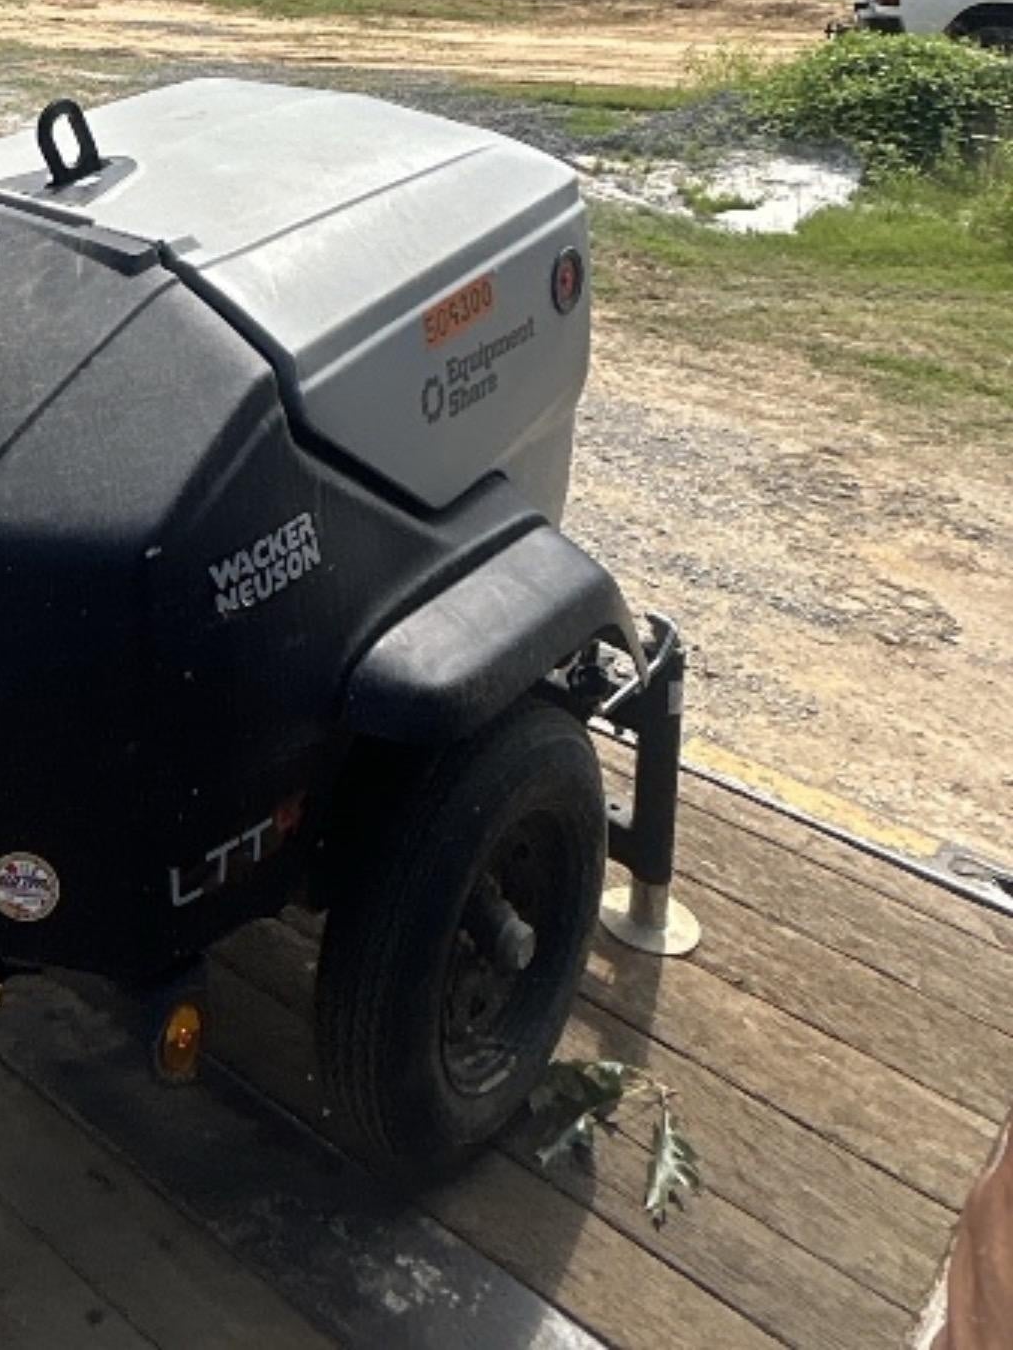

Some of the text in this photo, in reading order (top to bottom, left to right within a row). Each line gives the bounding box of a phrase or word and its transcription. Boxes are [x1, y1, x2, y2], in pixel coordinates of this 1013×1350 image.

[446, 318, 535, 387] Equipment
[448, 372, 499, 418] Share
[208, 511, 316, 590] WACKER
[214, 536, 321, 615] NEUSON
